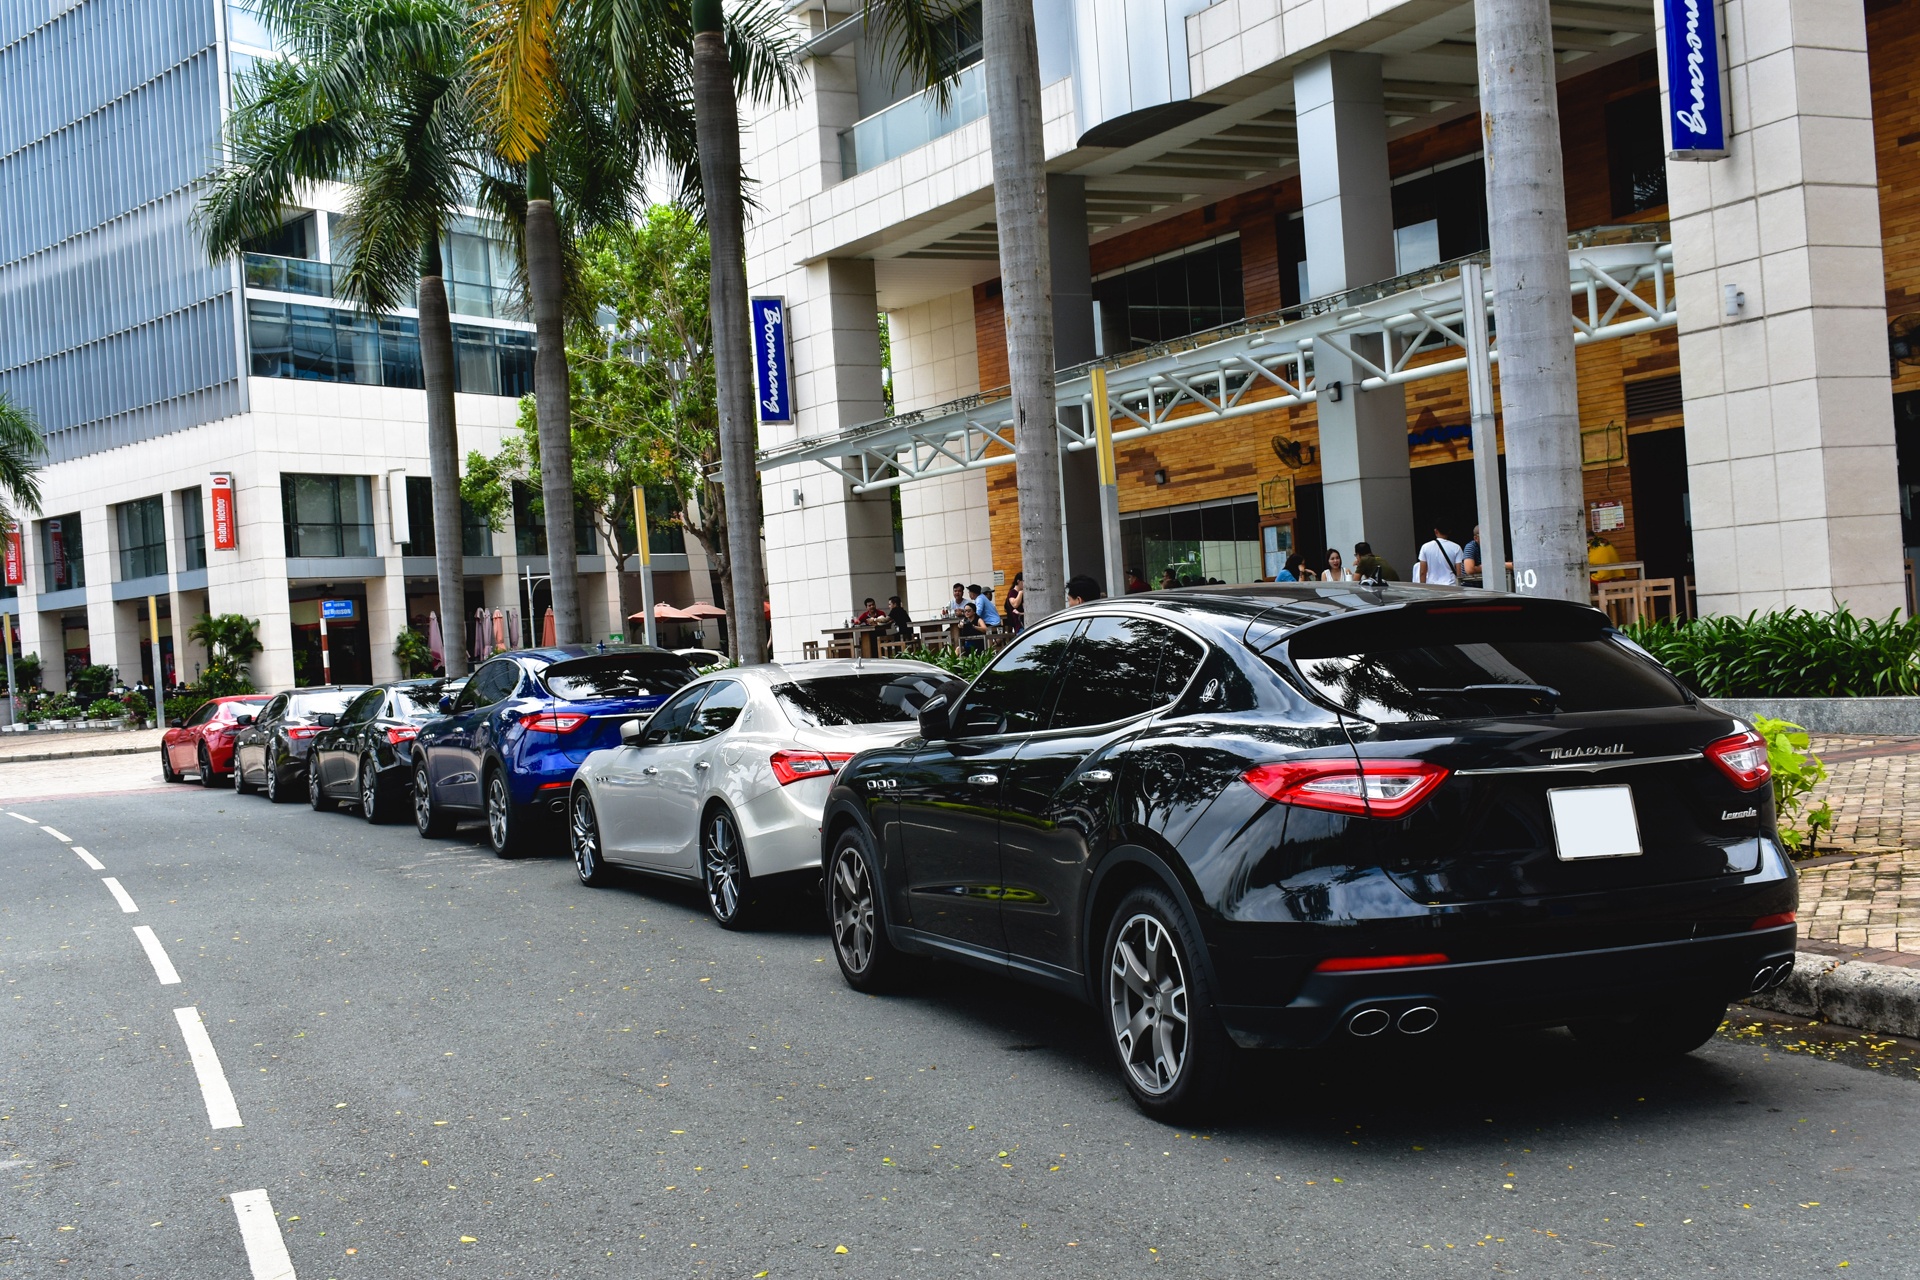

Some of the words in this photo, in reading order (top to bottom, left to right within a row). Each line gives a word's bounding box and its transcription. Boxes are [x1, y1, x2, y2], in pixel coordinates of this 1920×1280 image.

[763, 307, 782, 414] Boomerang
[217, 523, 227, 543] shabu
[8, 562, 17, 580] shabu
[1516, 569, 1537, 592] 40
[1540, 743, 1634, 760] Maserati
[1721, 807, 1757, 821] Levante
